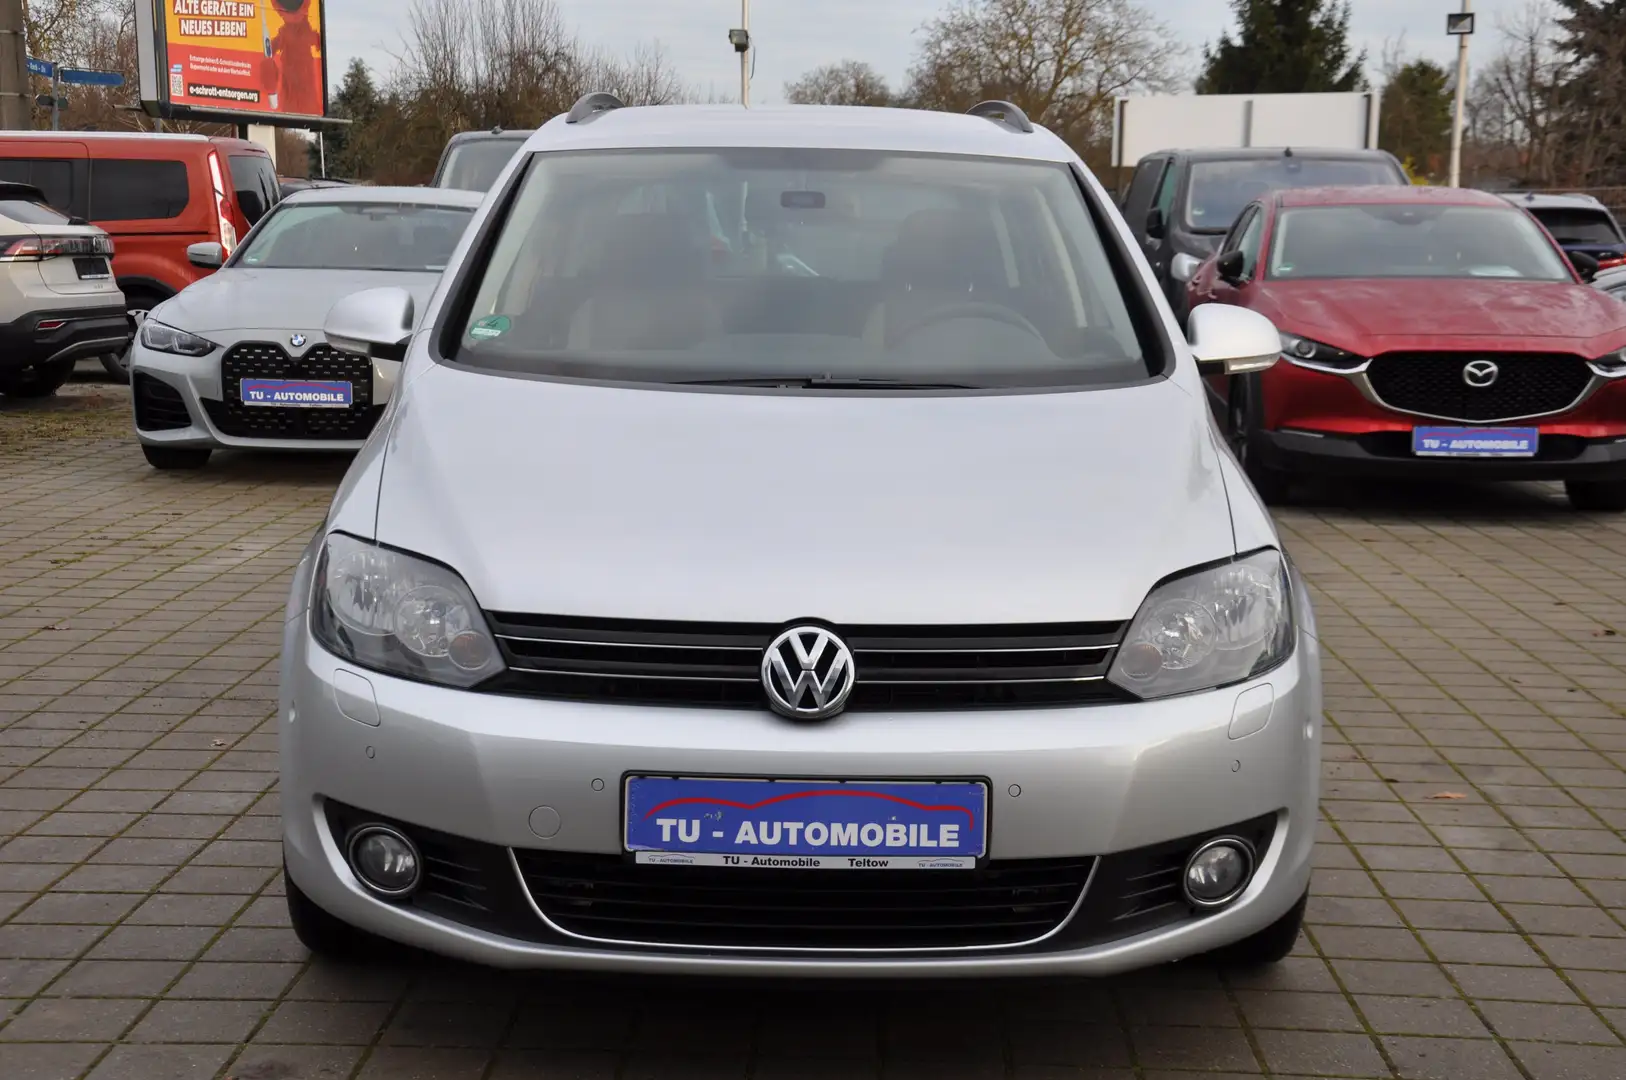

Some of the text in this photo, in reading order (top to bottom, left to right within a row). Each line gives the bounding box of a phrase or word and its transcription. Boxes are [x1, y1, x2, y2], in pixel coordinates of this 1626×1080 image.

[174, 0, 199, 15] ALTE
[239, 3, 254, 17] EIN
[181, 19, 246, 37] NEUES LEBEN!
[189, 85, 258, 102] e-schrott-entsorgen.org
[249, 391, 264, 400] TU
[274, 392, 344, 402] AUTOMOBILE
[1422, 439, 1440, 449] TU
[1449, 440, 1529, 450] AUTOMOBILE
[656, 818, 700, 843] TU
[734, 821, 960, 848] AUTOMOBILE
[723, 856, 740, 865] TU
[751, 856, 821, 867] Automobile
[848, 858, 889, 868] Teltow
